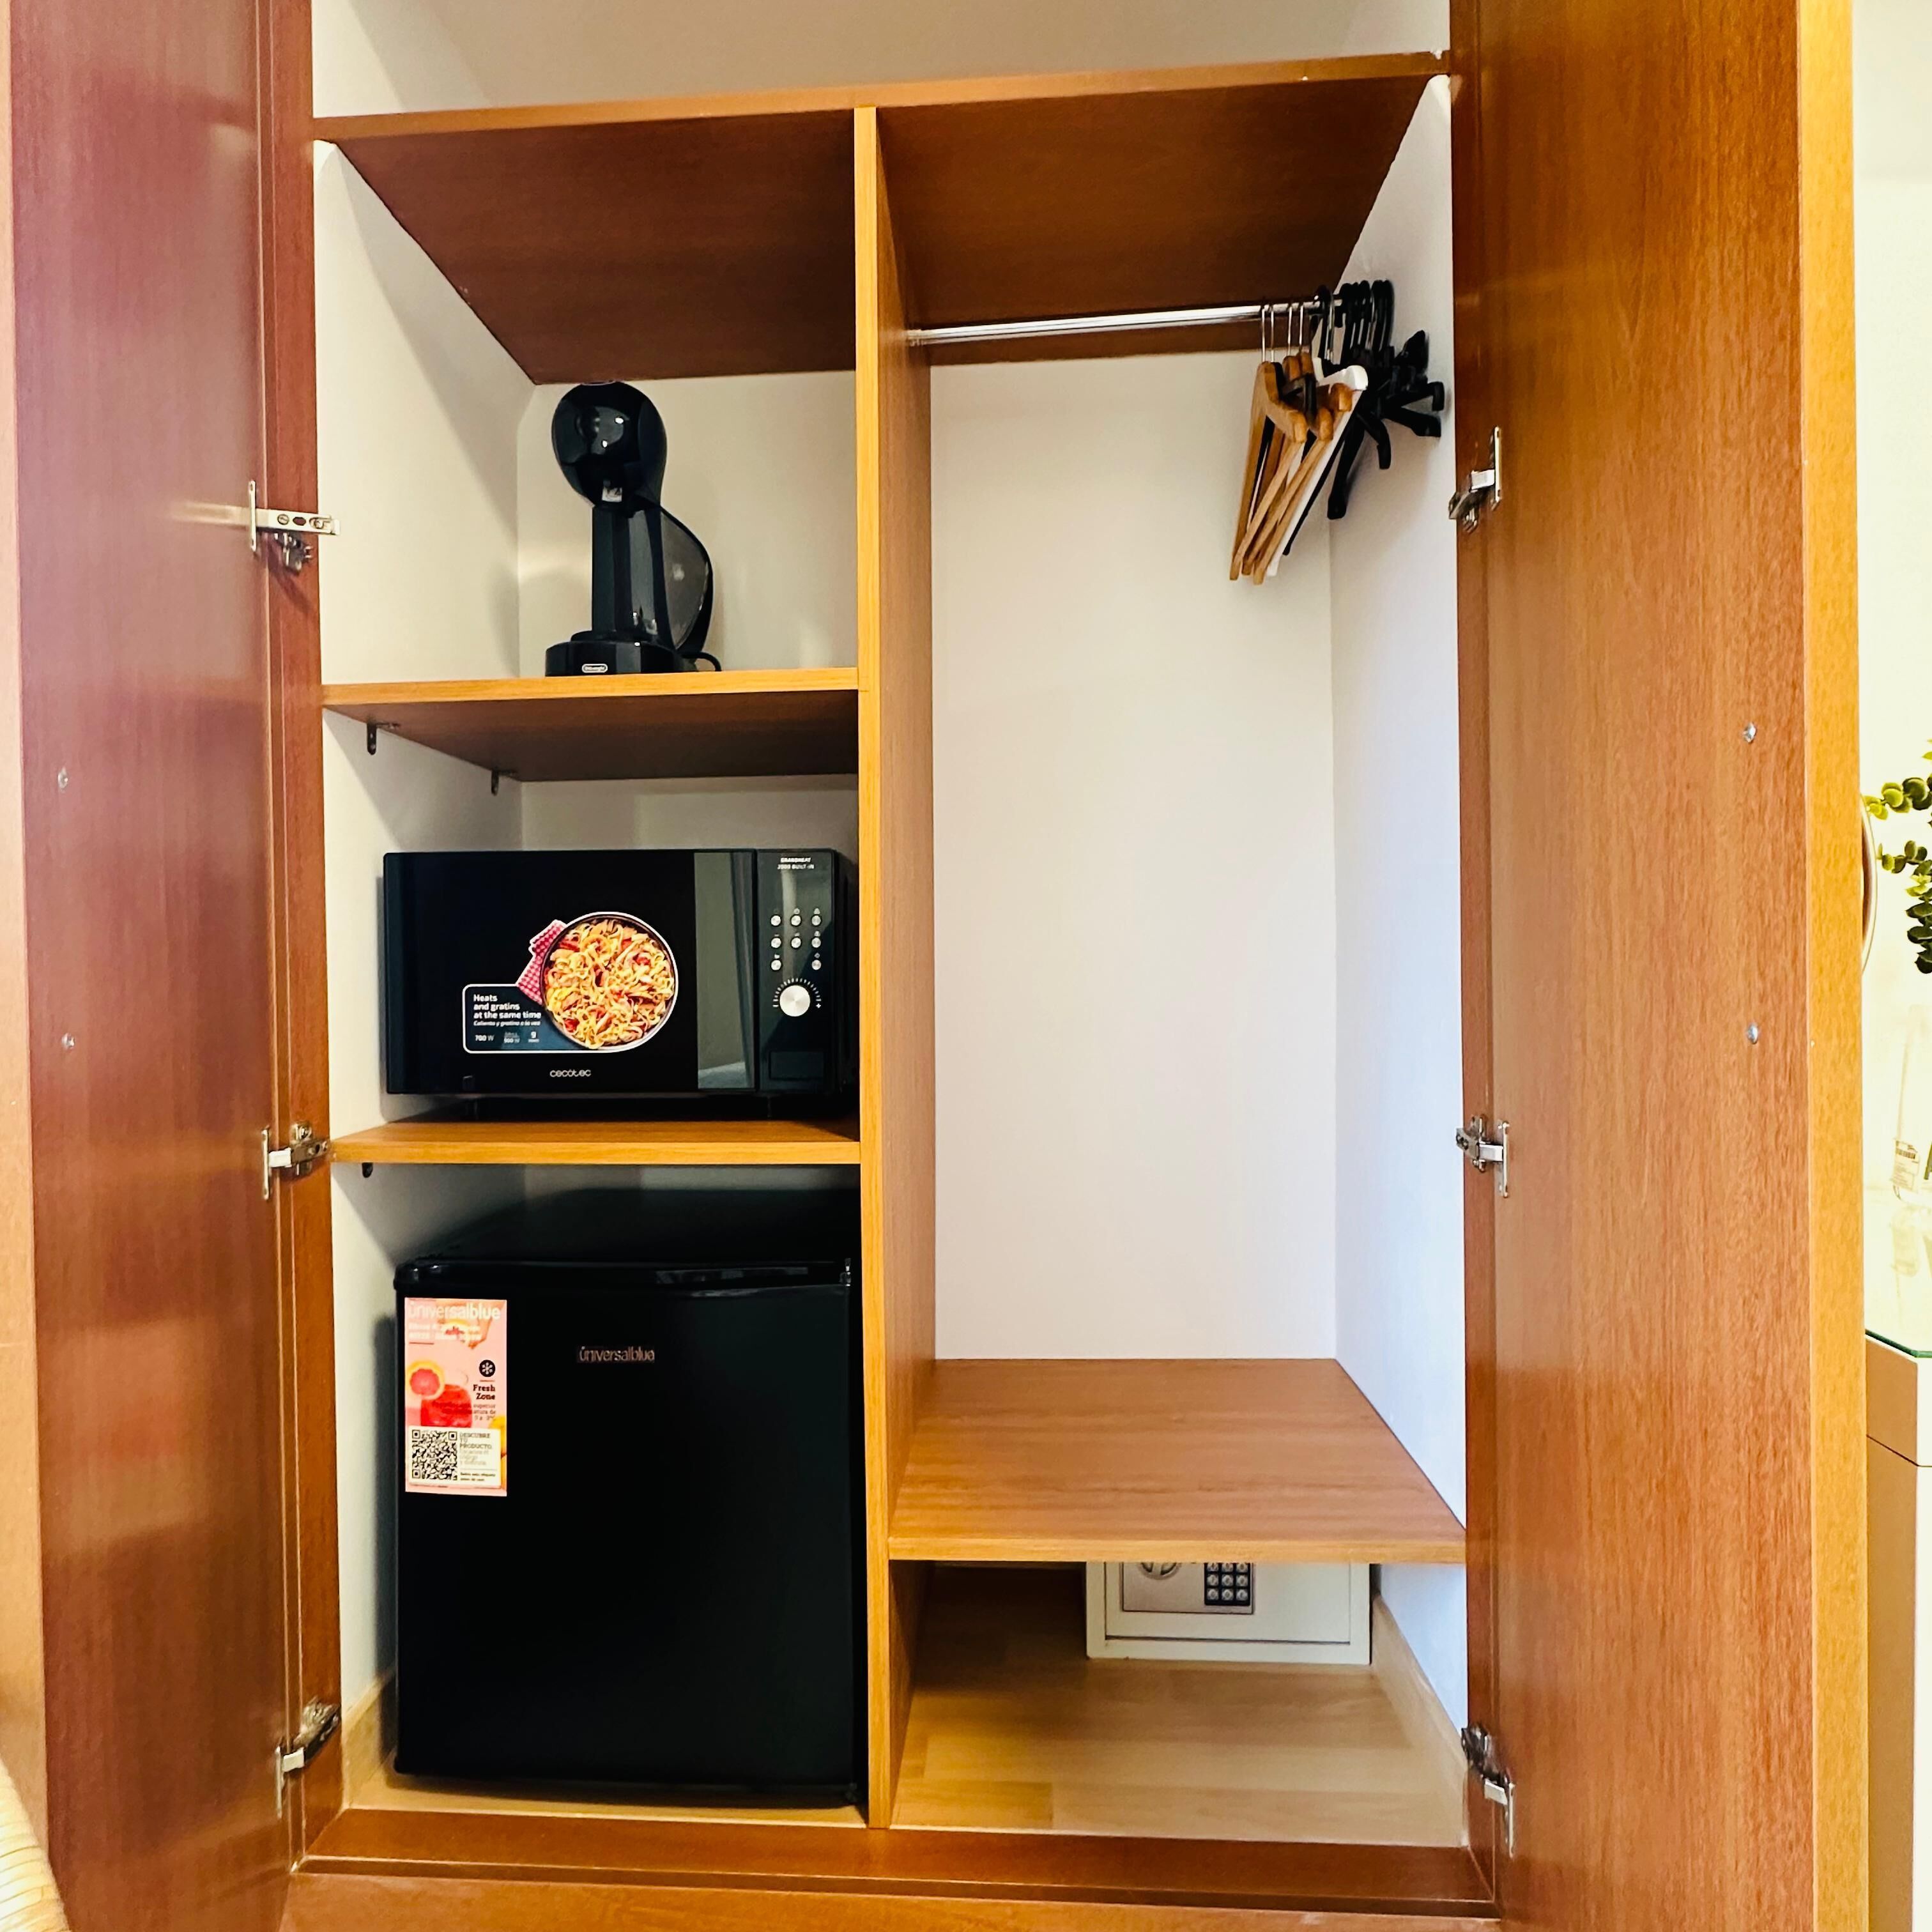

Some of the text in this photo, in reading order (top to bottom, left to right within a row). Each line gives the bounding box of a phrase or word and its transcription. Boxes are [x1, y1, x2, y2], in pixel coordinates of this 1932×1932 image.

[491, 1002, 521, 1012] gratins
[484, 1011, 498, 1019] the
[523, 1011, 542, 1019] time
[549, 1069, 592, 1077] cecotec
